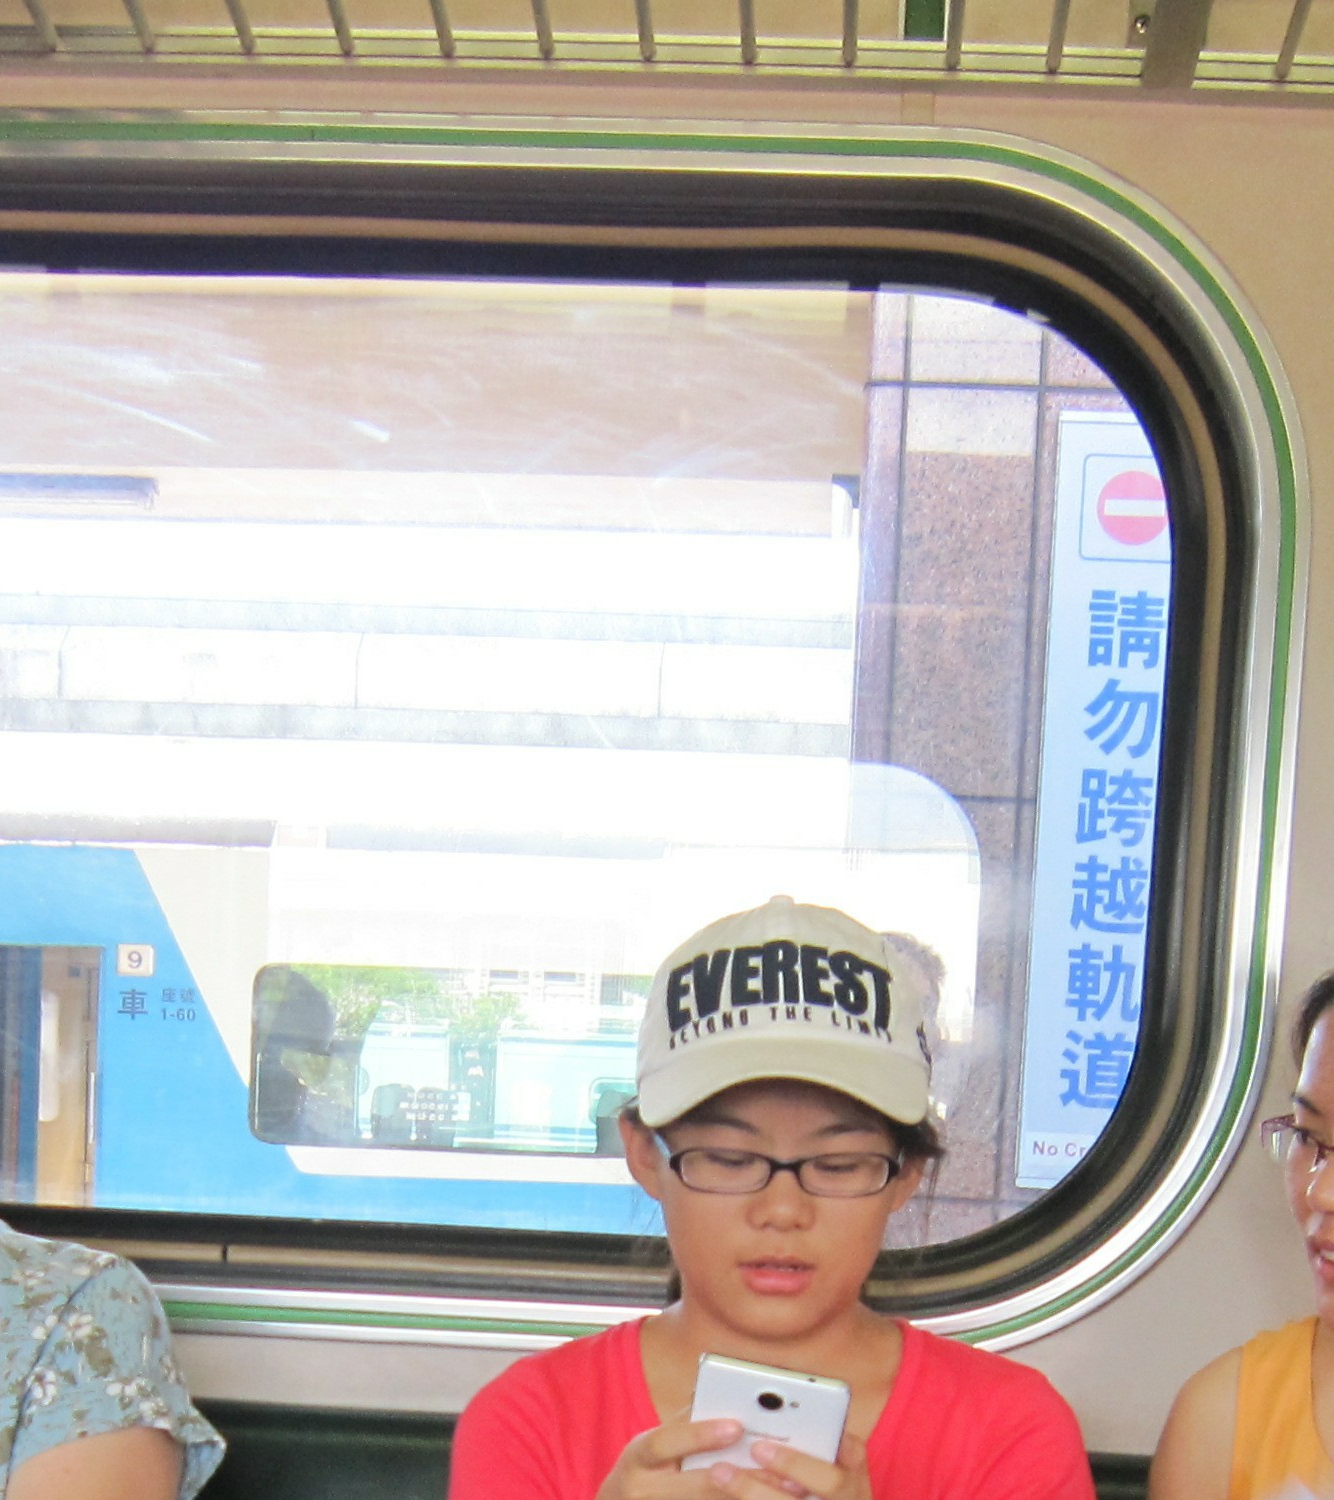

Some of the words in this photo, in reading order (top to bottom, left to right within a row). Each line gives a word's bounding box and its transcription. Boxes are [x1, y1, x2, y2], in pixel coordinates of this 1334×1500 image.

[1059, 590, 1165, 1109] 請勿跨越軌道
[127, 951, 142, 969] 9
[667, 939, 892, 1033] EVEREST
[117, 989, 148, 1020] 車
[770, 1006, 812, 1021] THE
[161, 1008, 196, 1021] 1-60
[1032, 1141, 1058, 1156] No
